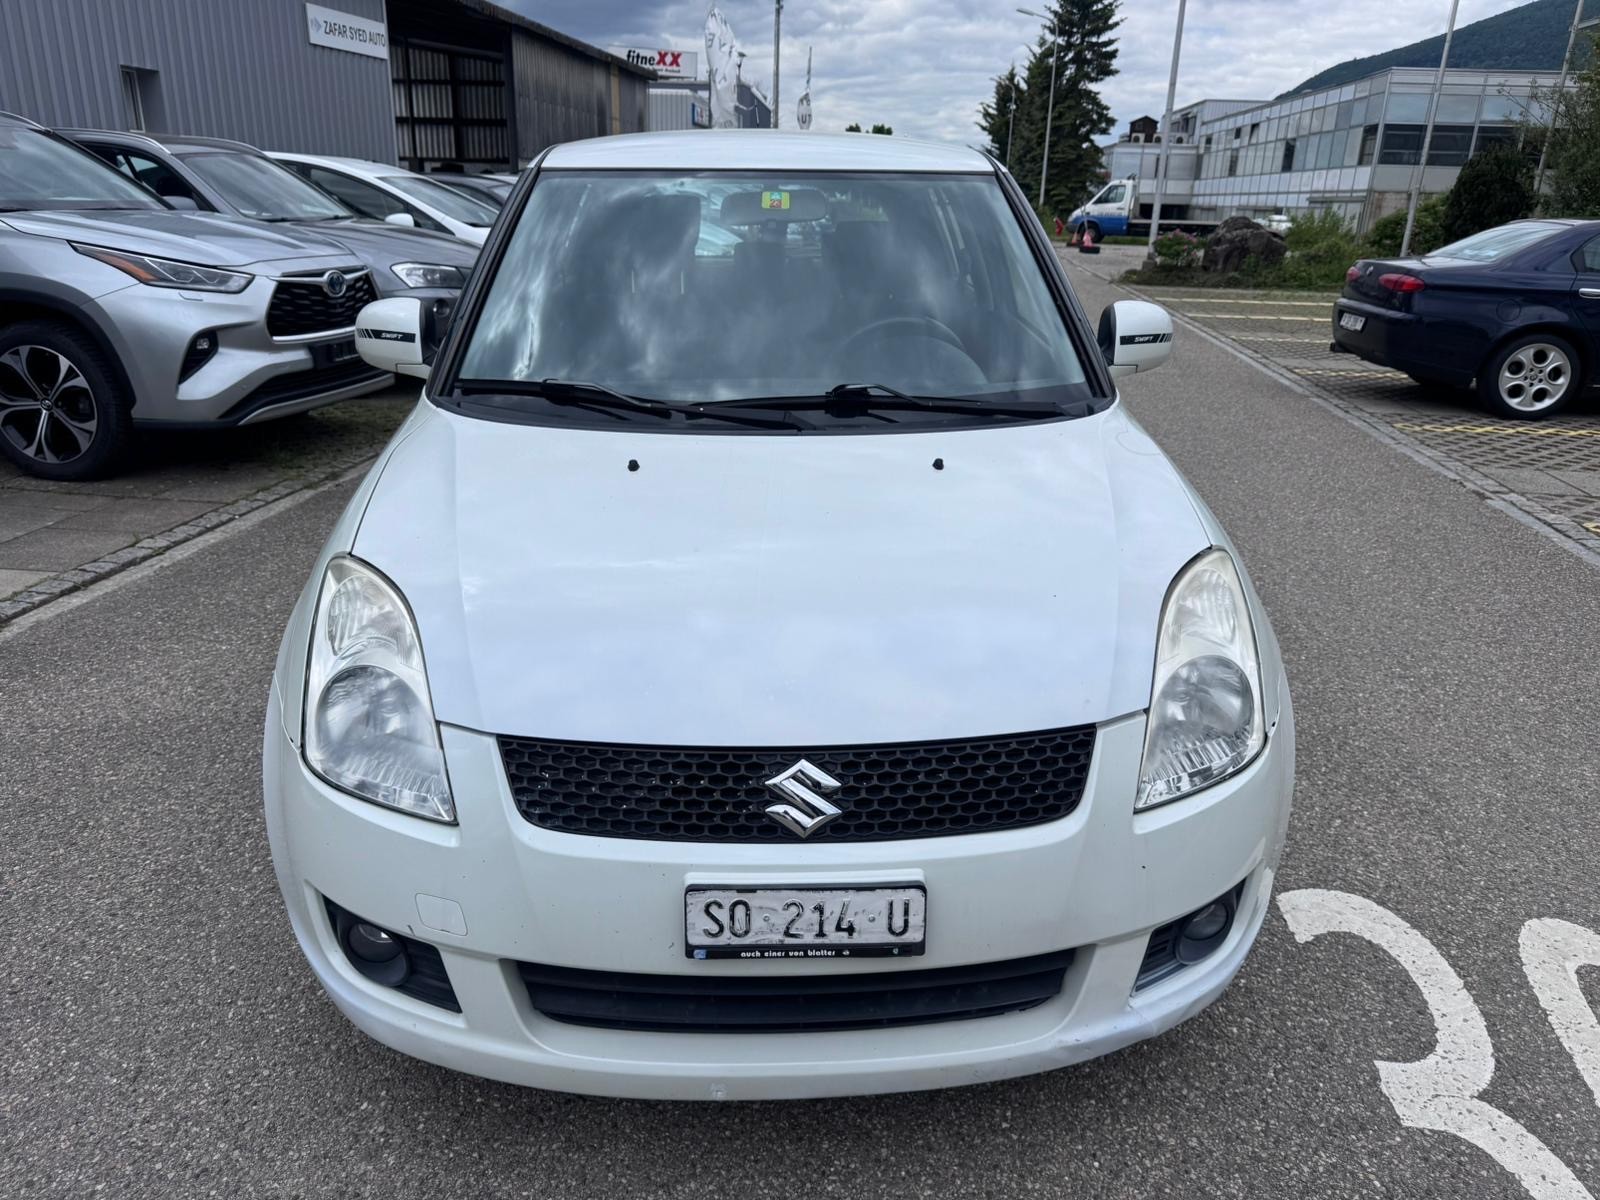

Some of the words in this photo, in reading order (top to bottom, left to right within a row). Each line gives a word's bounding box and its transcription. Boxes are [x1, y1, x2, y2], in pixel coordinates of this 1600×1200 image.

[323, 20, 348, 39] ZAFAR
[349, 26, 367, 43] SYED
[368, 32, 385, 47] AUTO
[626, 49, 682, 67] fitneXX
[782, 898, 856, 939] 214
[887, 898, 911, 937] U
[740, 950, 761, 958] auch
